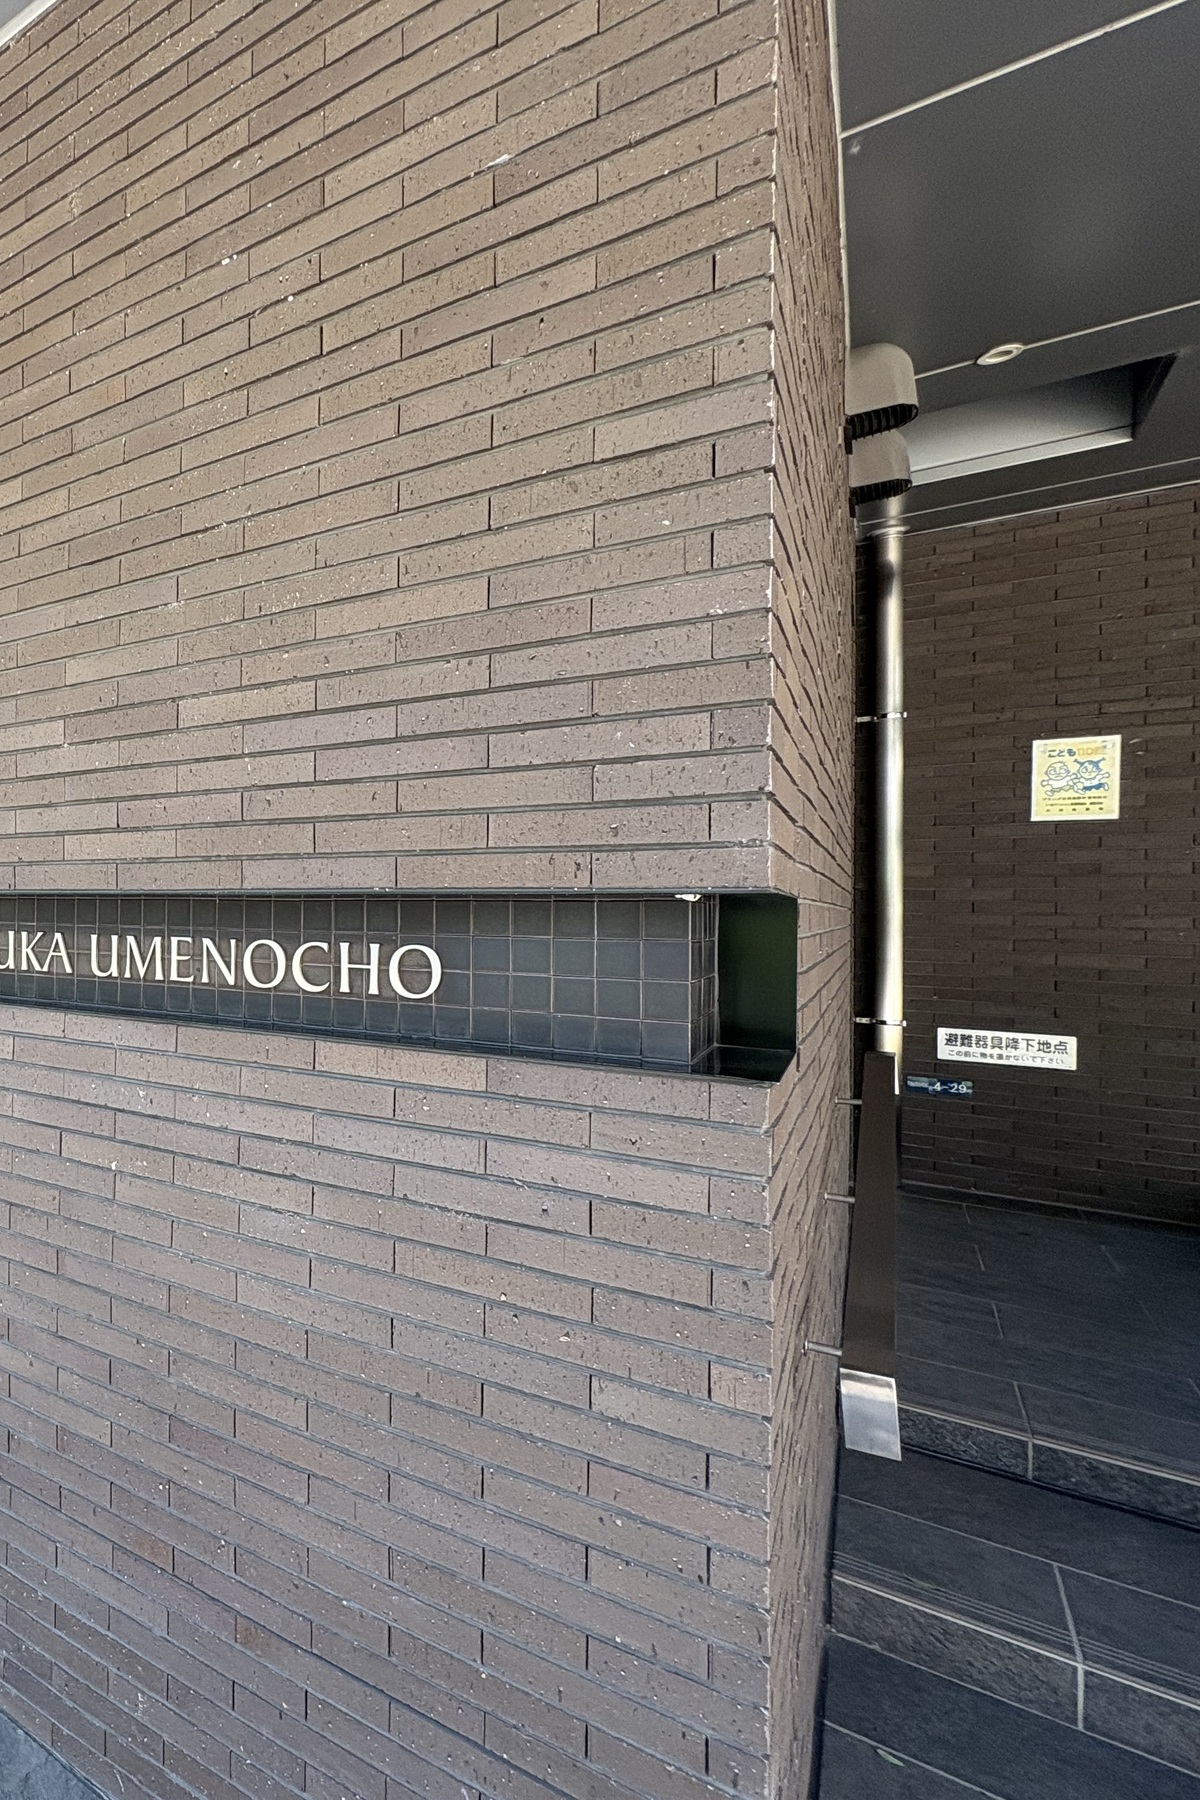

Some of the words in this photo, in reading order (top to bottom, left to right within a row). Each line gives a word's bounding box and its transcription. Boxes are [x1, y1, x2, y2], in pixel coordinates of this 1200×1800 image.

[90, 934, 442, 999] UMENOCHO
[944, 1032, 1069, 1055] 避難器具降下地点
